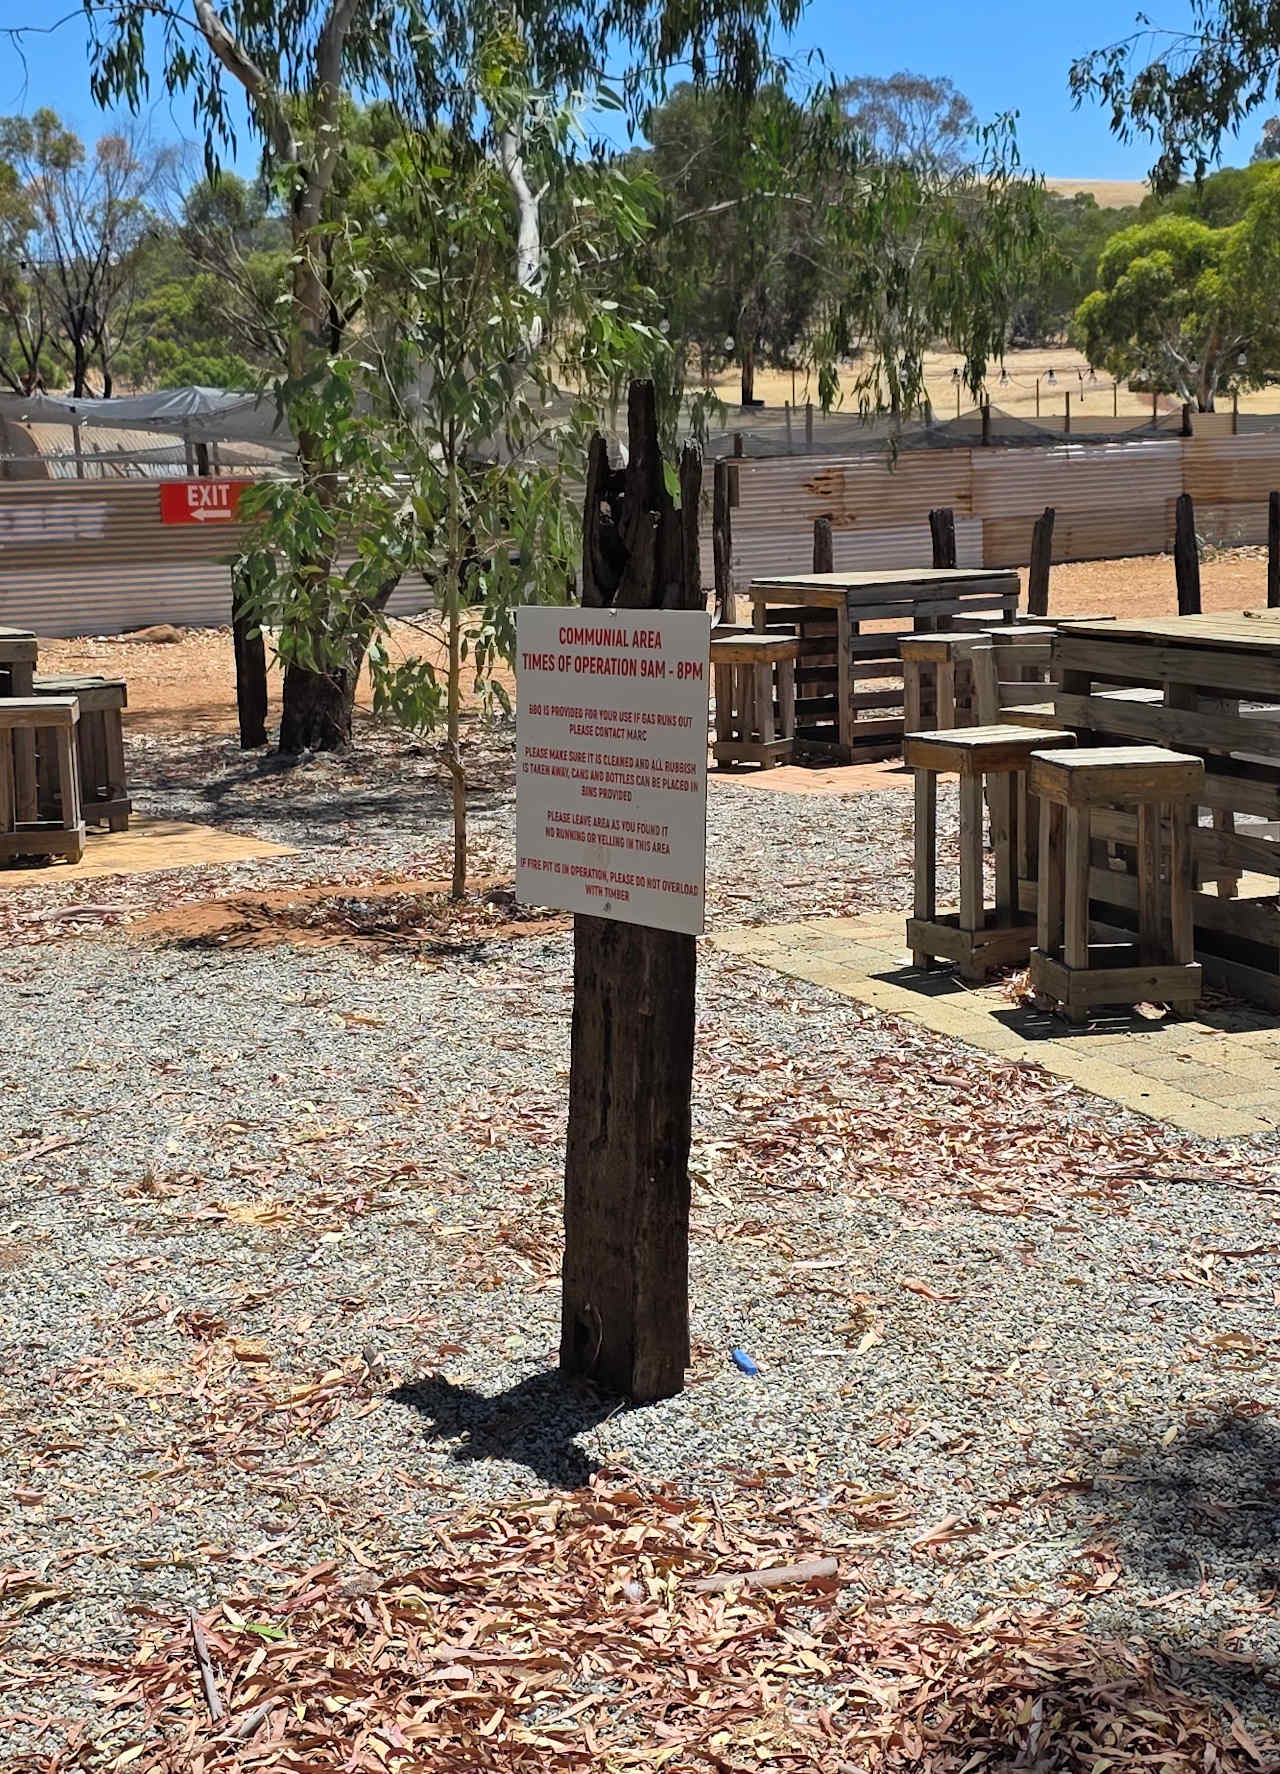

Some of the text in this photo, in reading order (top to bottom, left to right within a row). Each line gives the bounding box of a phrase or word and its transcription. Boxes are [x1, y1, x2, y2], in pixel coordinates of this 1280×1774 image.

[187, 485, 230, 506] EXIT
[559, 627, 662, 649] COMMUNIAL AREA
[522, 653, 555, 672] TIMES
[558, 655, 572, 673] OF
[574, 656, 637, 677] OPERATION
[640, 659, 665, 679] 9AM
[677, 662, 703, 680] 8PM
[529, 704, 693, 728] BBQ IS PROVIDED FOR YOUR USE IF GAS RUNS OUT
[569, 723, 647, 741] PLEASE CONTACT MARC
[525, 746, 696, 775] PLEASE MAKE SURE IT IS CLEANED AND ALL RUBBISH
[522, 762, 529, 773] IS
[530, 763, 550, 776] TAKEN
[571, 767, 589, 780] CANS
[591, 769, 604, 781] AND
[605, 771, 635, 785] BOTTLES
[636, 775, 650, 787] CAN
[652, 777, 660, 788] BE
[662, 778, 689, 791] PLACED
[690, 781, 698, 793] IN
[581, 785, 632, 802] BINS PROVIDED
[547, 810, 668, 837] PLEASE LEAVE AREA AS YOU FOUND IT
[545, 827, 670, 855] NO RUNNING OR YELLING IN THIS AREA
[520, 857, 526, 867] IF
[527, 858, 542, 870] FIRE
[543, 861, 552, 872] PIT
[554, 862, 561, 873] IS
[562, 863, 569, 874] IN
[610, 872, 634, 885] PLEASE
[636, 876, 645, 887] DO
[647, 877, 661, 889] NOT
[662, 881, 698, 896] OVERLOAD
[585, 884, 629, 901] WITH TIMBER
